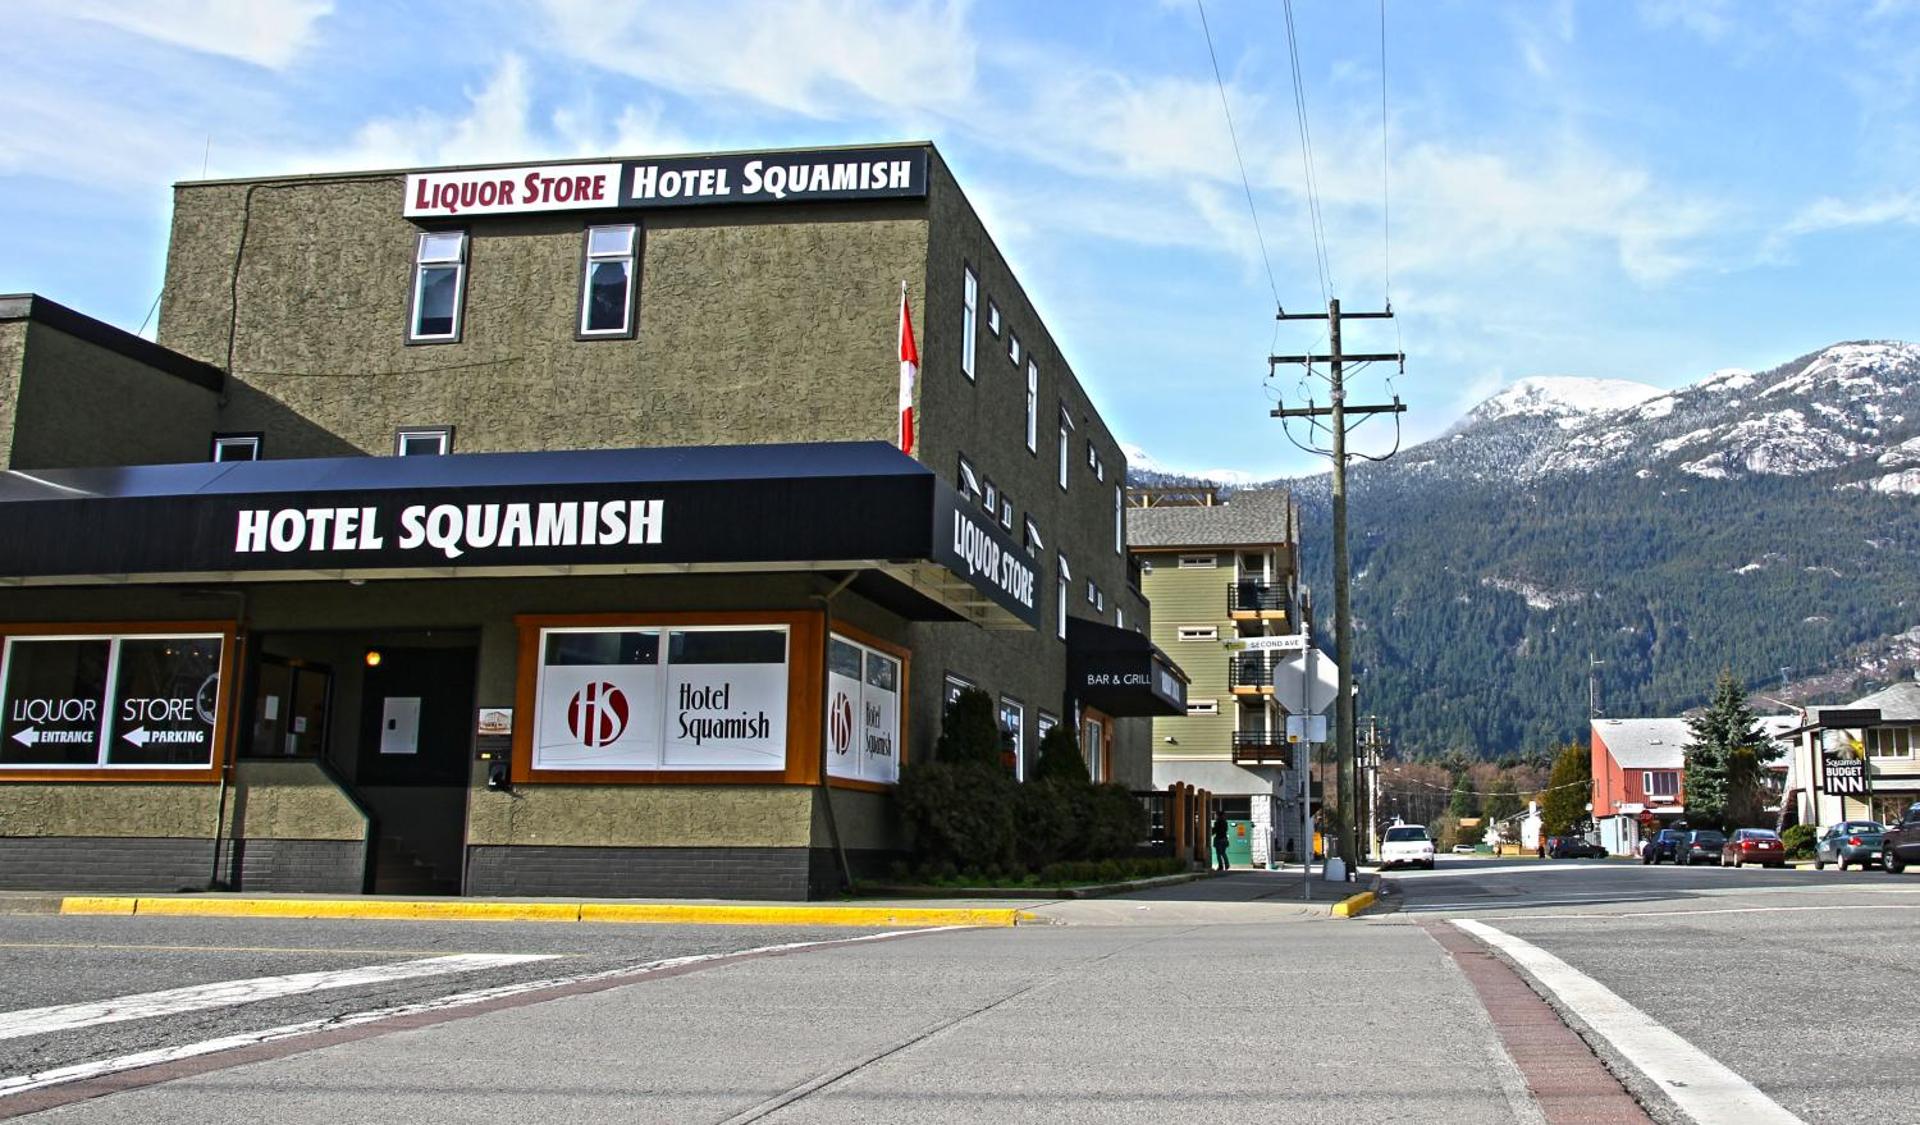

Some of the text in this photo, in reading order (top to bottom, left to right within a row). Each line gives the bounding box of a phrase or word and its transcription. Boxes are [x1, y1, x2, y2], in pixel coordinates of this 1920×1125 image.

[631, 160, 912, 200] HOTEL SQUAMISH
[415, 172, 606, 213] LIQUOR STORE
[235, 500, 665, 558] HOTEL SQUAMISH
[954, 508, 1035, 609] LIQUOR STORE
[1250, 640, 1283, 649] SECOND
[1087, 674, 1152, 685] BAR & GRILL
[679, 683, 729, 710] Hotel
[13, 698, 194, 724] LIQUOR STORE
[41, 731, 94, 743] ENTRANCE
[151, 731, 204, 743] PARKING
[678, 711, 769, 746] Squamish
[1826, 758, 1862, 767] Squamish
[1826, 767, 1862, 776] BUDGET
[1827, 777, 1863, 793] INN
